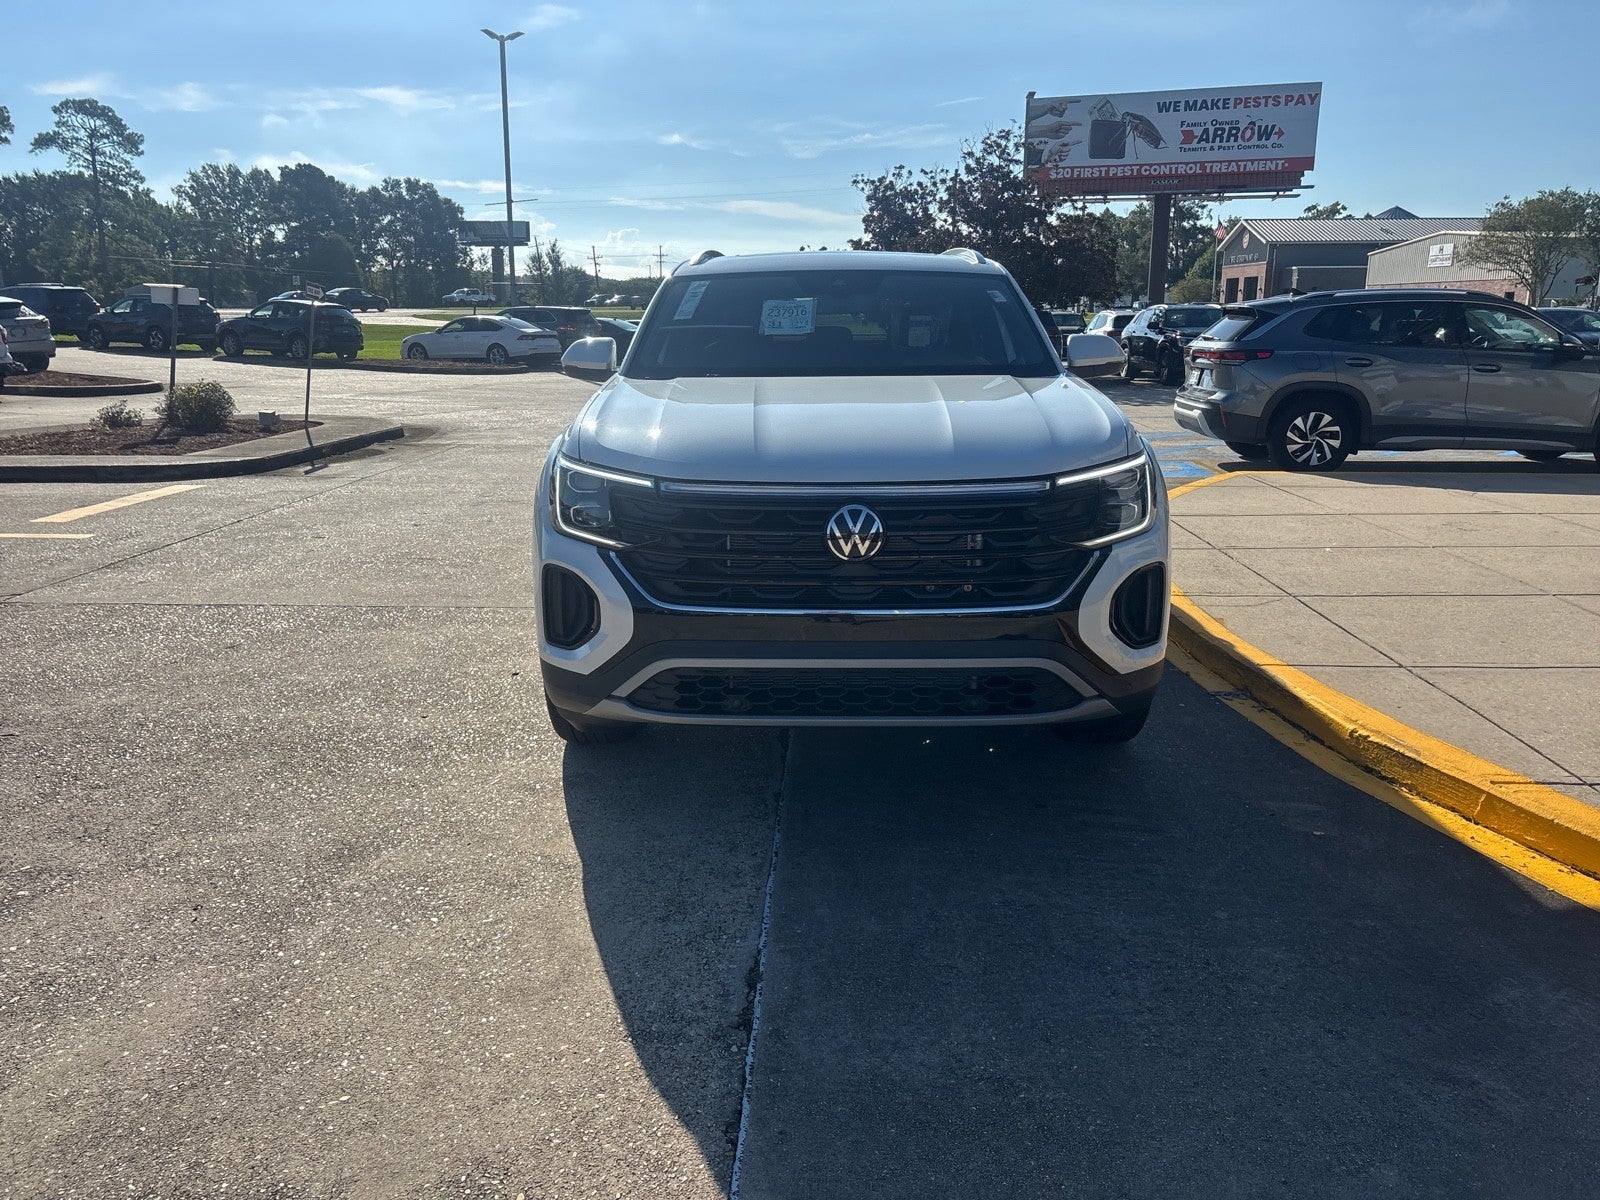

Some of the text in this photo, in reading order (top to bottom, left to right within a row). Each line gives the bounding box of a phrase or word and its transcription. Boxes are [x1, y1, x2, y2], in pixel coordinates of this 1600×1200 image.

[1156, 93, 1320, 113] WE MAKE PESTS PAY
[1180, 119, 1240, 128] FAMILY OWNED
[1196, 124, 1277, 144] ARROW
[1049, 168, 1072, 179] $20
[1073, 167, 1108, 178] FIRST
[1109, 165, 1140, 177] PEST
[1141, 163, 1203, 176] CONTROL
